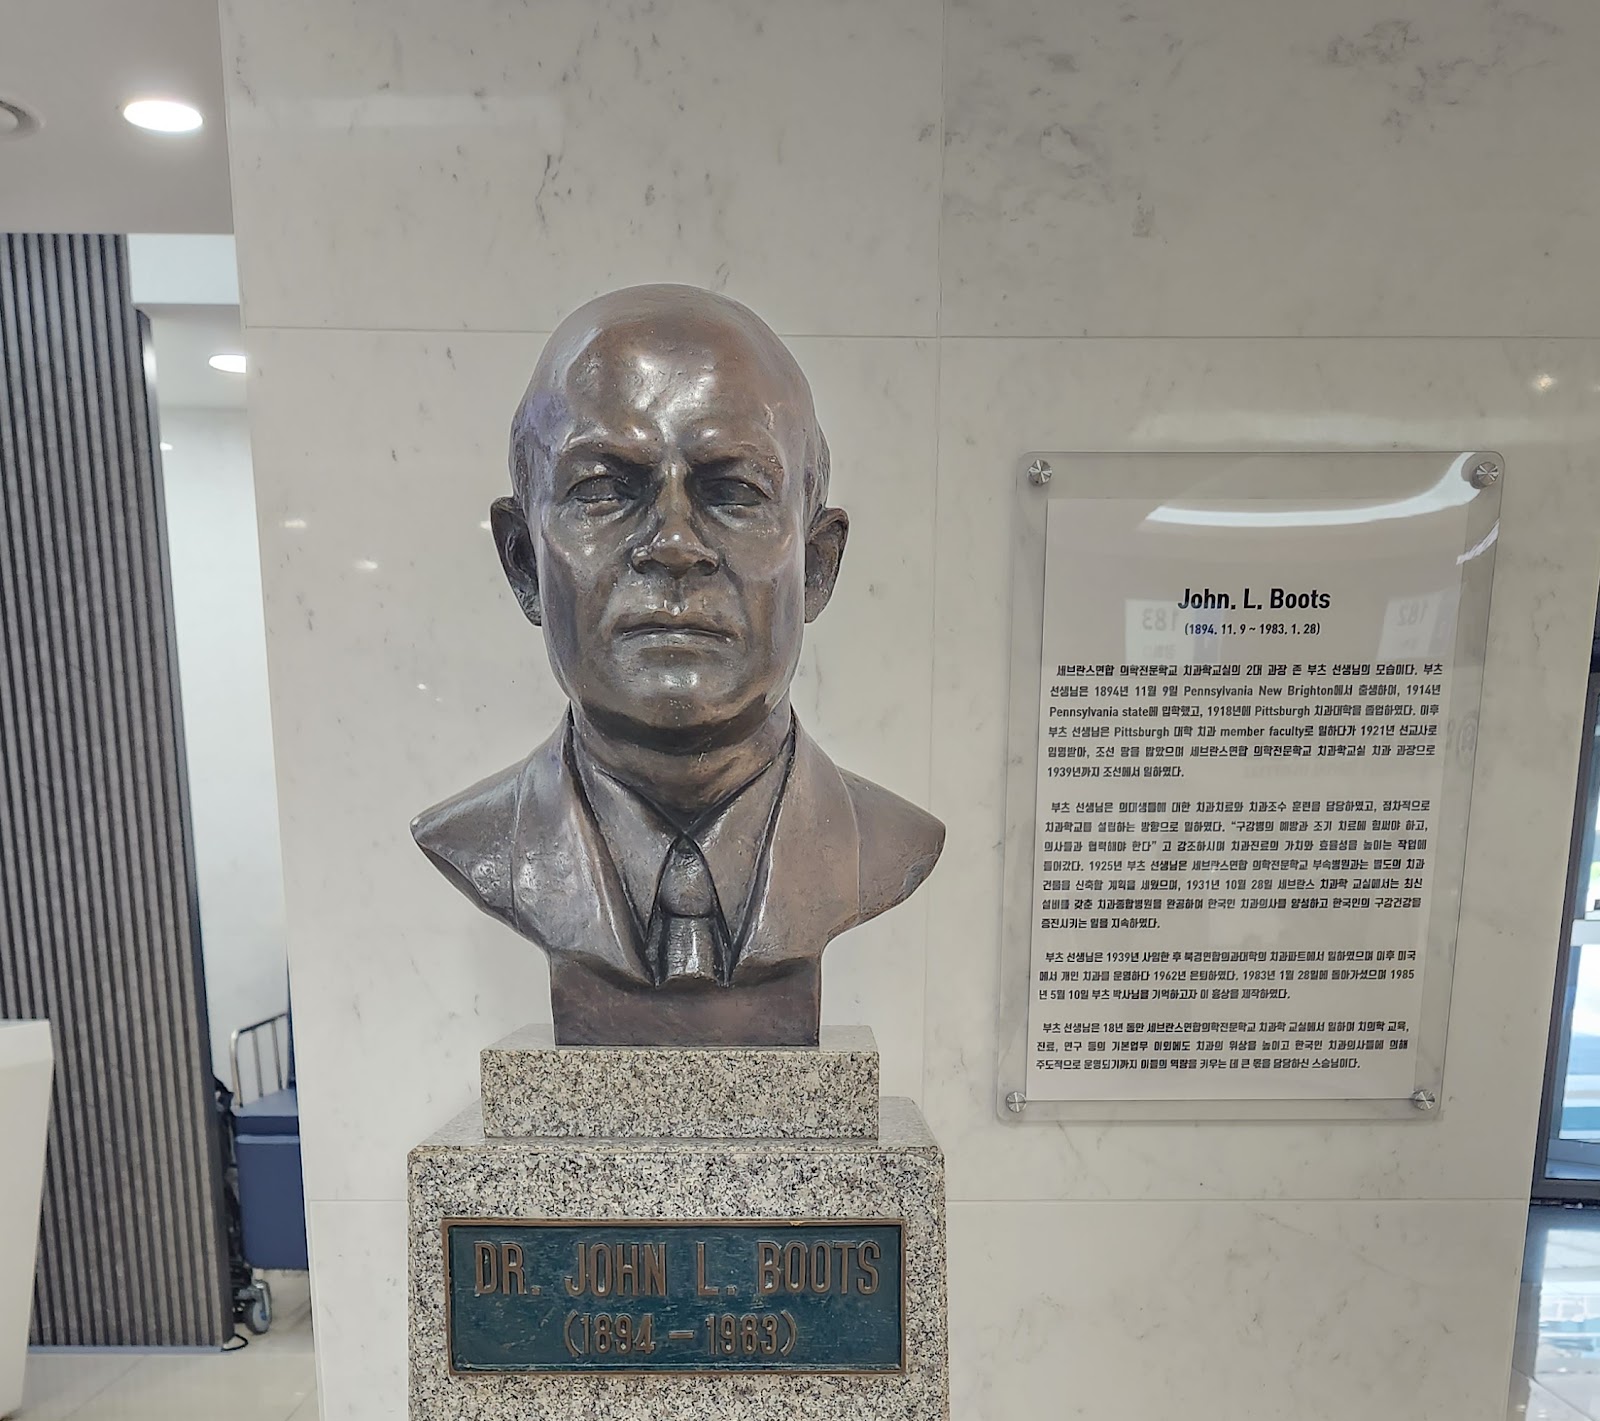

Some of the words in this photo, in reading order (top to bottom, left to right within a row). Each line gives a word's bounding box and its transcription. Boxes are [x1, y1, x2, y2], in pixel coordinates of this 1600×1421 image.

[1178, 588, 1236, 610] John.
[1244, 588, 1262, 610] L.
[1270, 588, 1330, 609] Boots
[1185, 623, 1217, 635] (1894.
[1222, 624, 1236, 635] 11.
[1240, 624, 1246, 634] 9
[1260, 623, 1287, 635] 1983.
[1291, 624, 1300, 635] 1.
[1303, 623, 1320, 635] 28)
[1246, 665, 1262, 675] 2대
[1267, 664, 1288, 675] 과장
[1292, 665, 1302, 676] 존
[1307, 664, 1326, 675] 부츠
[1332, 664, 1370, 675] 선생님의
[1424, 663, 1443, 675] 부츠
[1050, 686, 1088, 697] 선생님은
[1135, 685, 1156, 697] 11월
[1162, 685, 1178, 697] 9일
[1184, 685, 1253, 697] Pennsylvania
[1259, 685, 1282, 696] New
[1050, 706, 1118, 718] Pennsylvania
[1255, 706, 1310, 717] Pittsburgh
[1420, 704, 1439, 715] 이후
[1048, 726, 1067, 737] 부츠
[1072, 726, 1110, 737] 선생님은
[1114, 726, 1169, 738] Pittsburgh
[1174, 726, 1193, 737] 대학
[1197, 726, 1216, 737] 치과
[1220, 726, 1265, 737] member
[1318, 725, 1356, 736] 일하다가
[1399, 724, 1437, 736] 선교사로
[1096, 747, 1114, 757] 조선
[1372, 745, 1391, 756] 치과
[1396, 745, 1435, 755] 과장으로
[1103, 766, 1140, 777] 조선에서
[1052, 802, 1070, 813] 부츠
[1076, 802, 1113, 813] 선생님은
[1172, 801, 1191, 813] 대한
[1249, 801, 1286, 812] 치과조수
[1098, 821, 1135, 832] 설립하는
[1141, 821, 1178, 832] 방향으로
[1280, 821, 1308, 831] 예방과
[1313, 821, 1332, 831] 조기
[1338, 820, 1366, 831] 치료에
[1162, 841, 1172, 852] 고
[1284, 840, 1314, 851] 가치와
[1398, 839, 1426, 850] 작업에
[1127, 860, 1146, 871] 부츠
[1150, 860, 1187, 871] 선생님은
[1406, 858, 1425, 869] 치과
[1226, 879, 1246, 890] 10월
[1251, 879, 1272, 890] 28일
[1277, 879, 1315, 890] 세브란스
[1320, 878, 1348, 889] 치과학
[1404, 878, 1422, 888] 최신
[1167, 898, 1203, 909] 완공하여
[1208, 898, 1235, 909] 한국인
[1291, 898, 1328, 909] 양성하고
[1333, 897, 1370, 908] 한국인의
[474, 1241, 541, 1296] DR.
[564, 1241, 667, 1297] JOHN
[696, 1241, 737, 1296] L.
[757, 1240, 880, 1296] BOOTS
[563, 1310, 656, 1358] (1894
[705, 1310, 799, 1358] 1983)
